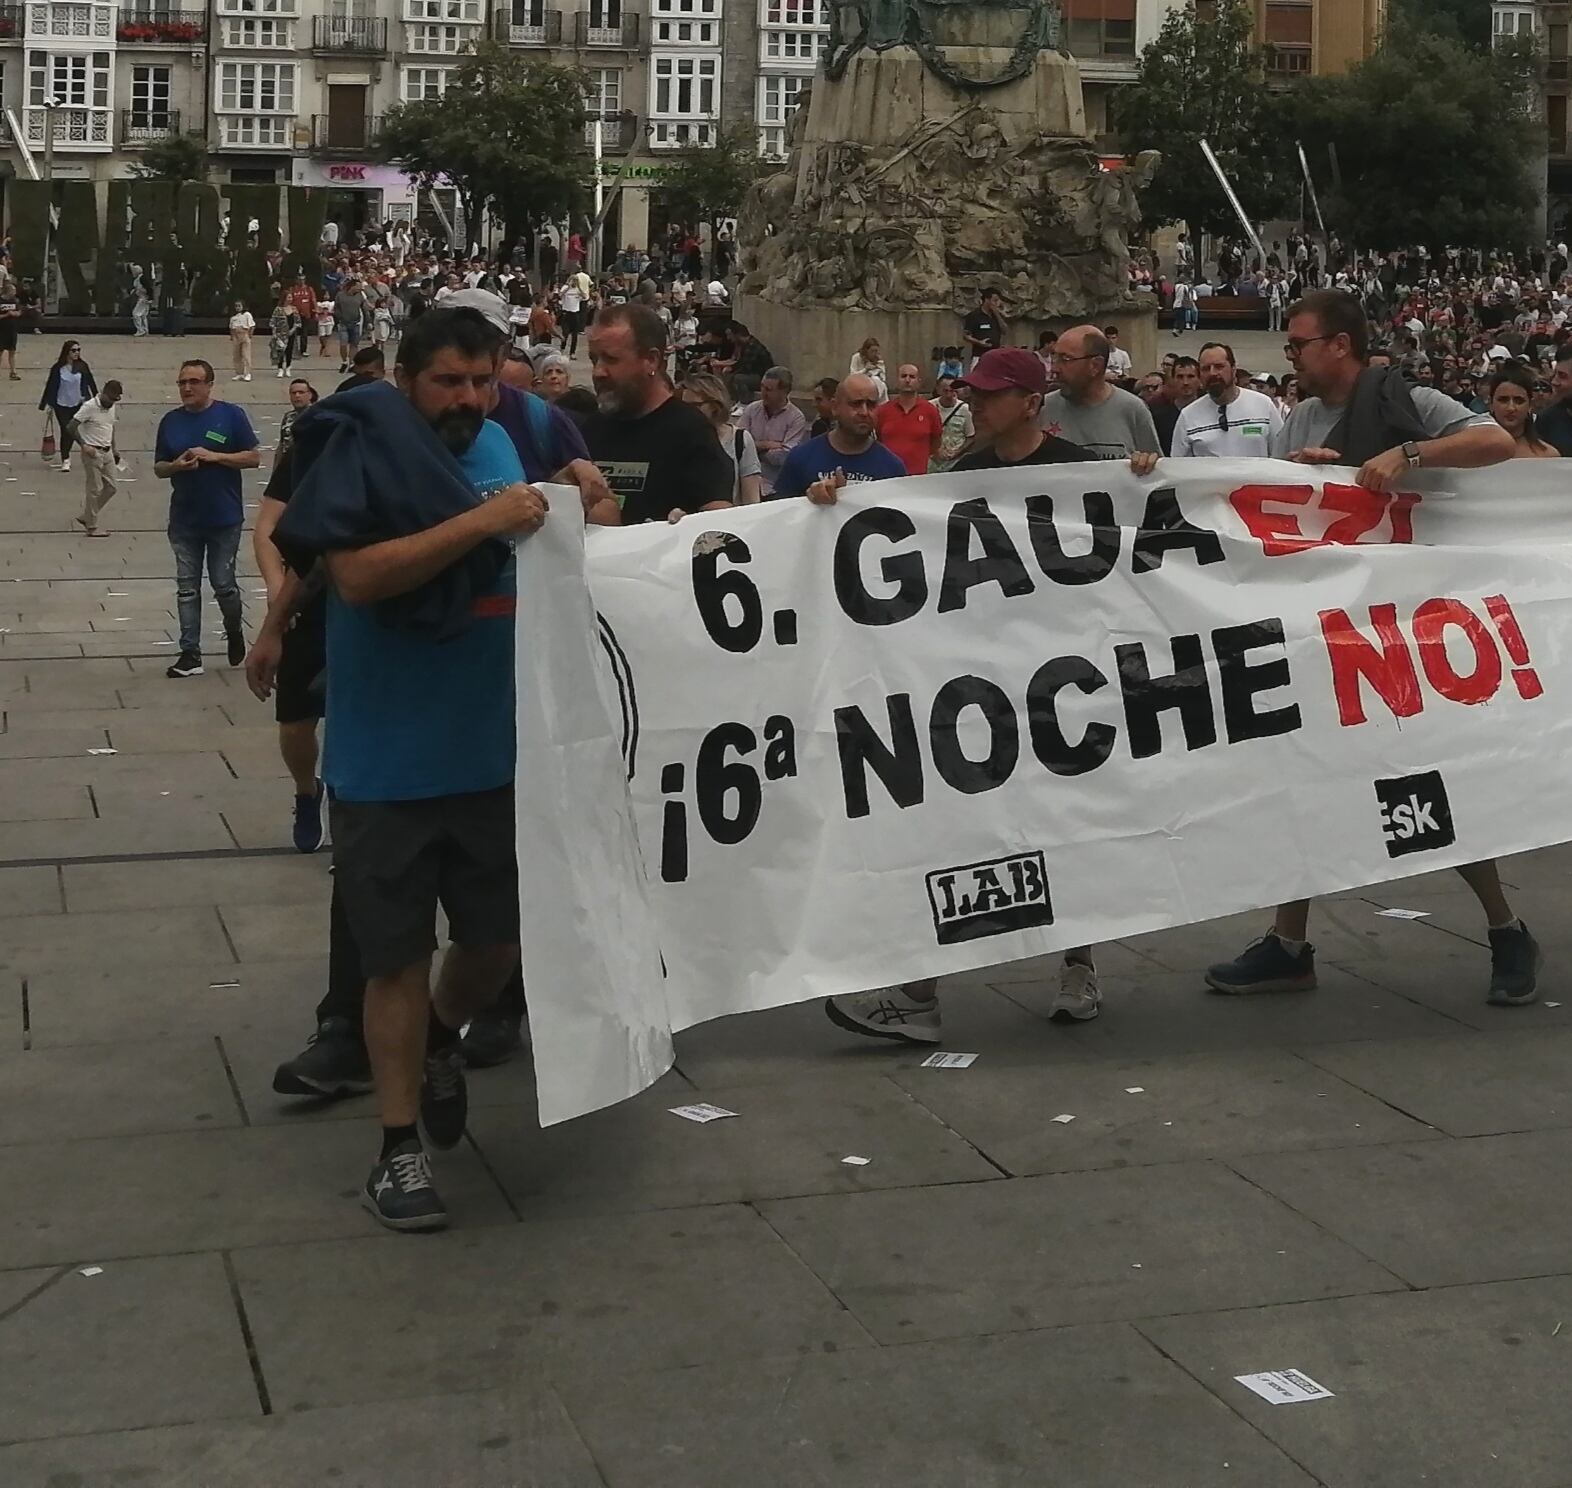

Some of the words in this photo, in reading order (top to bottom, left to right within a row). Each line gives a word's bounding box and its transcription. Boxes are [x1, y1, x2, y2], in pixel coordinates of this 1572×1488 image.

[692, 530, 797, 653] 6.
[834, 487, 1226, 626] GAUA
[833, 616, 1303, 819] NOCHE
[1317, 592, 1545, 727] NO!
[937, 859, 1043, 918] LAB
